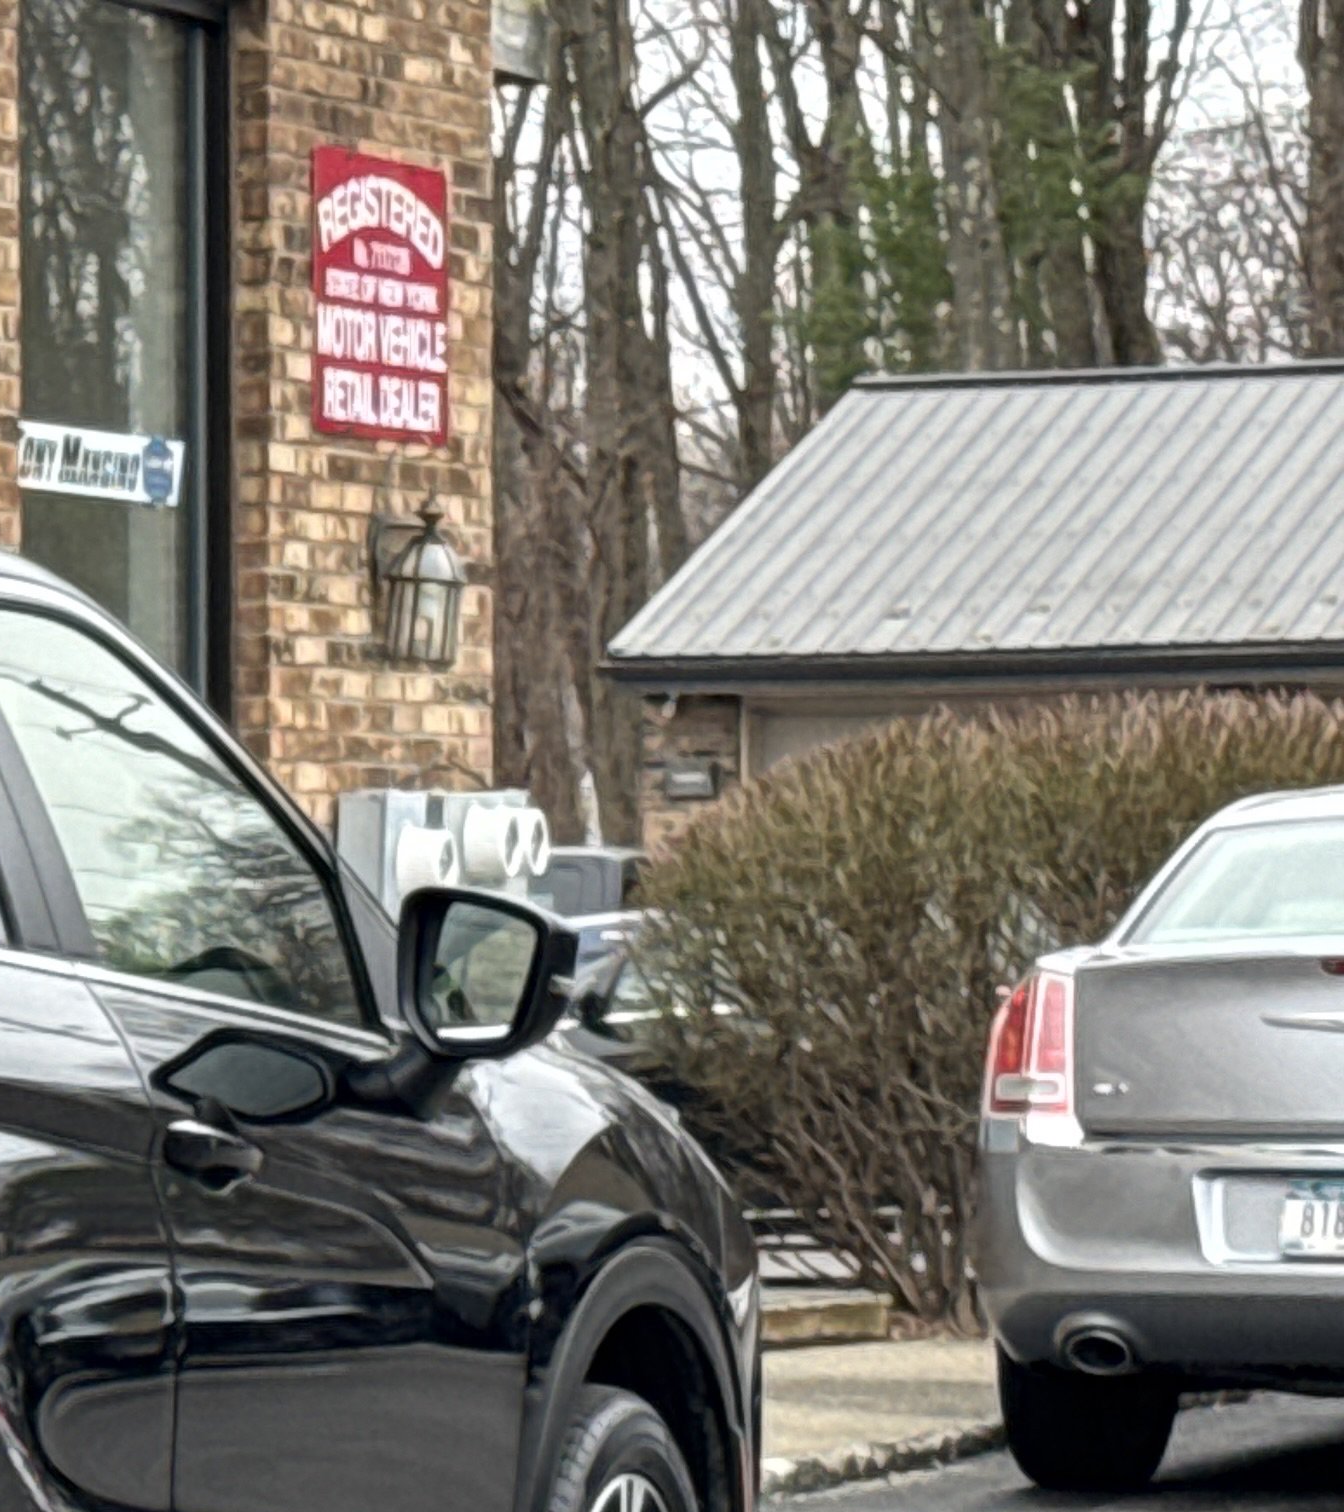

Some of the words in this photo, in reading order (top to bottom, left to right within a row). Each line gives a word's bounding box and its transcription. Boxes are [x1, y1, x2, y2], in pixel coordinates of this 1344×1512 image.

[317, 174, 443, 270] REGISTERED
[317, 302, 379, 362] MOTOR
[378, 312, 448, 373] VEHICLE
[323, 366, 379, 426] RETAIL
[378, 375, 442, 433] DEALER
